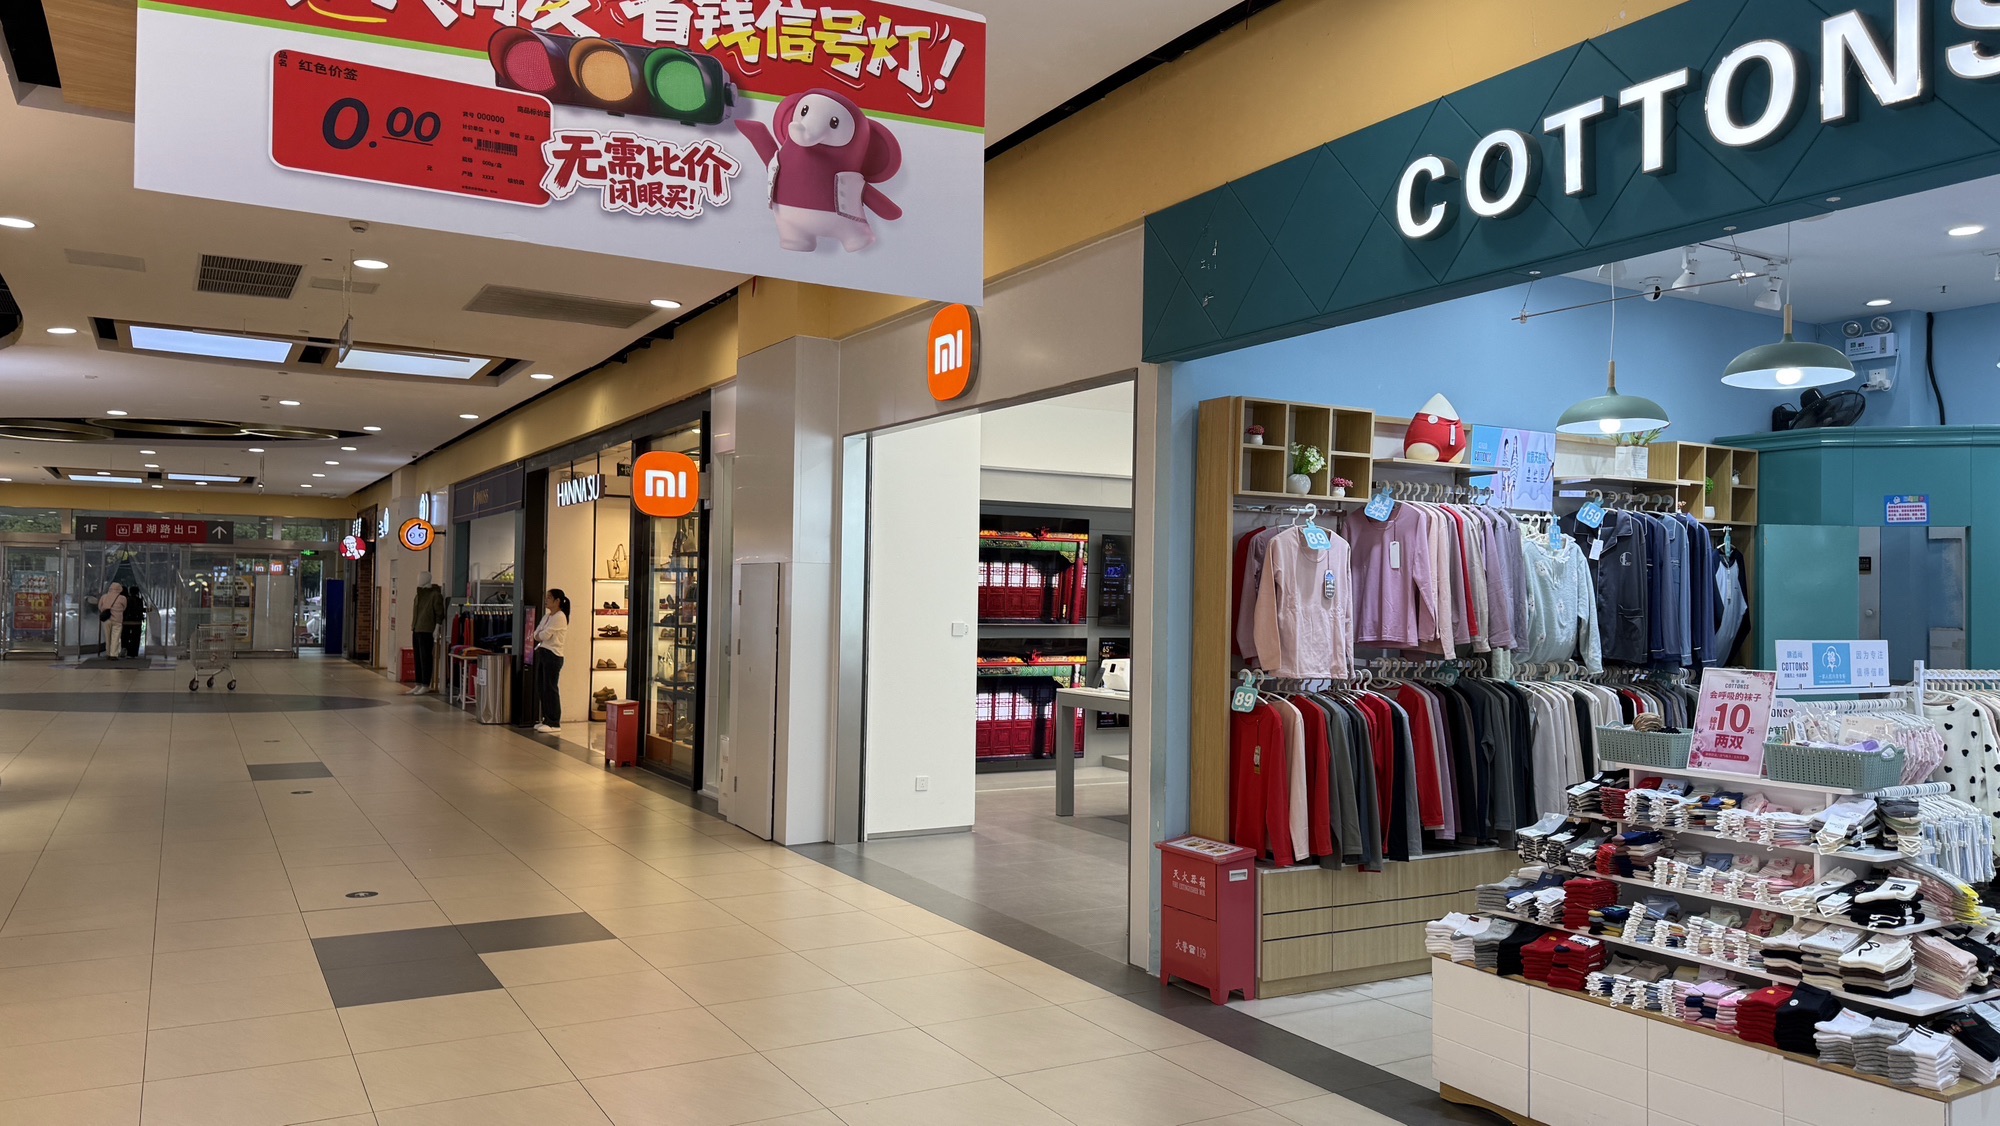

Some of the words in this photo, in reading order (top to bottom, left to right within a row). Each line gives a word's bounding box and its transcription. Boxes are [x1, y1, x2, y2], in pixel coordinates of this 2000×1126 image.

[278, 50, 288, 67] 品名
[298, 59, 358, 81] 红色价签
[322, 97, 441, 150] 0.00
[477, 112, 505, 123] 000000
[552, 136, 732, 197] 无需比价
[609, 178, 696, 211] 闭眼买!
[1582, 506, 1601, 523] 159
[84, 524, 98, 533] 1F
[132, 523, 198, 535] 星湖路出口
[1307, 532, 1325, 545] 89
[1855, 650, 1884, 660] 因为专注
[1781, 662, 1809, 671] COTTONSS
[1856, 667, 1884, 677] 值得信赖
[1234, 691, 1254, 706] 89
[1709, 690, 1762, 702] 会呼吸的袜子
[1715, 703, 1751, 733] 10
[1747, 726, 1755, 734] 元
[1714, 733, 1744, 749] 两双
